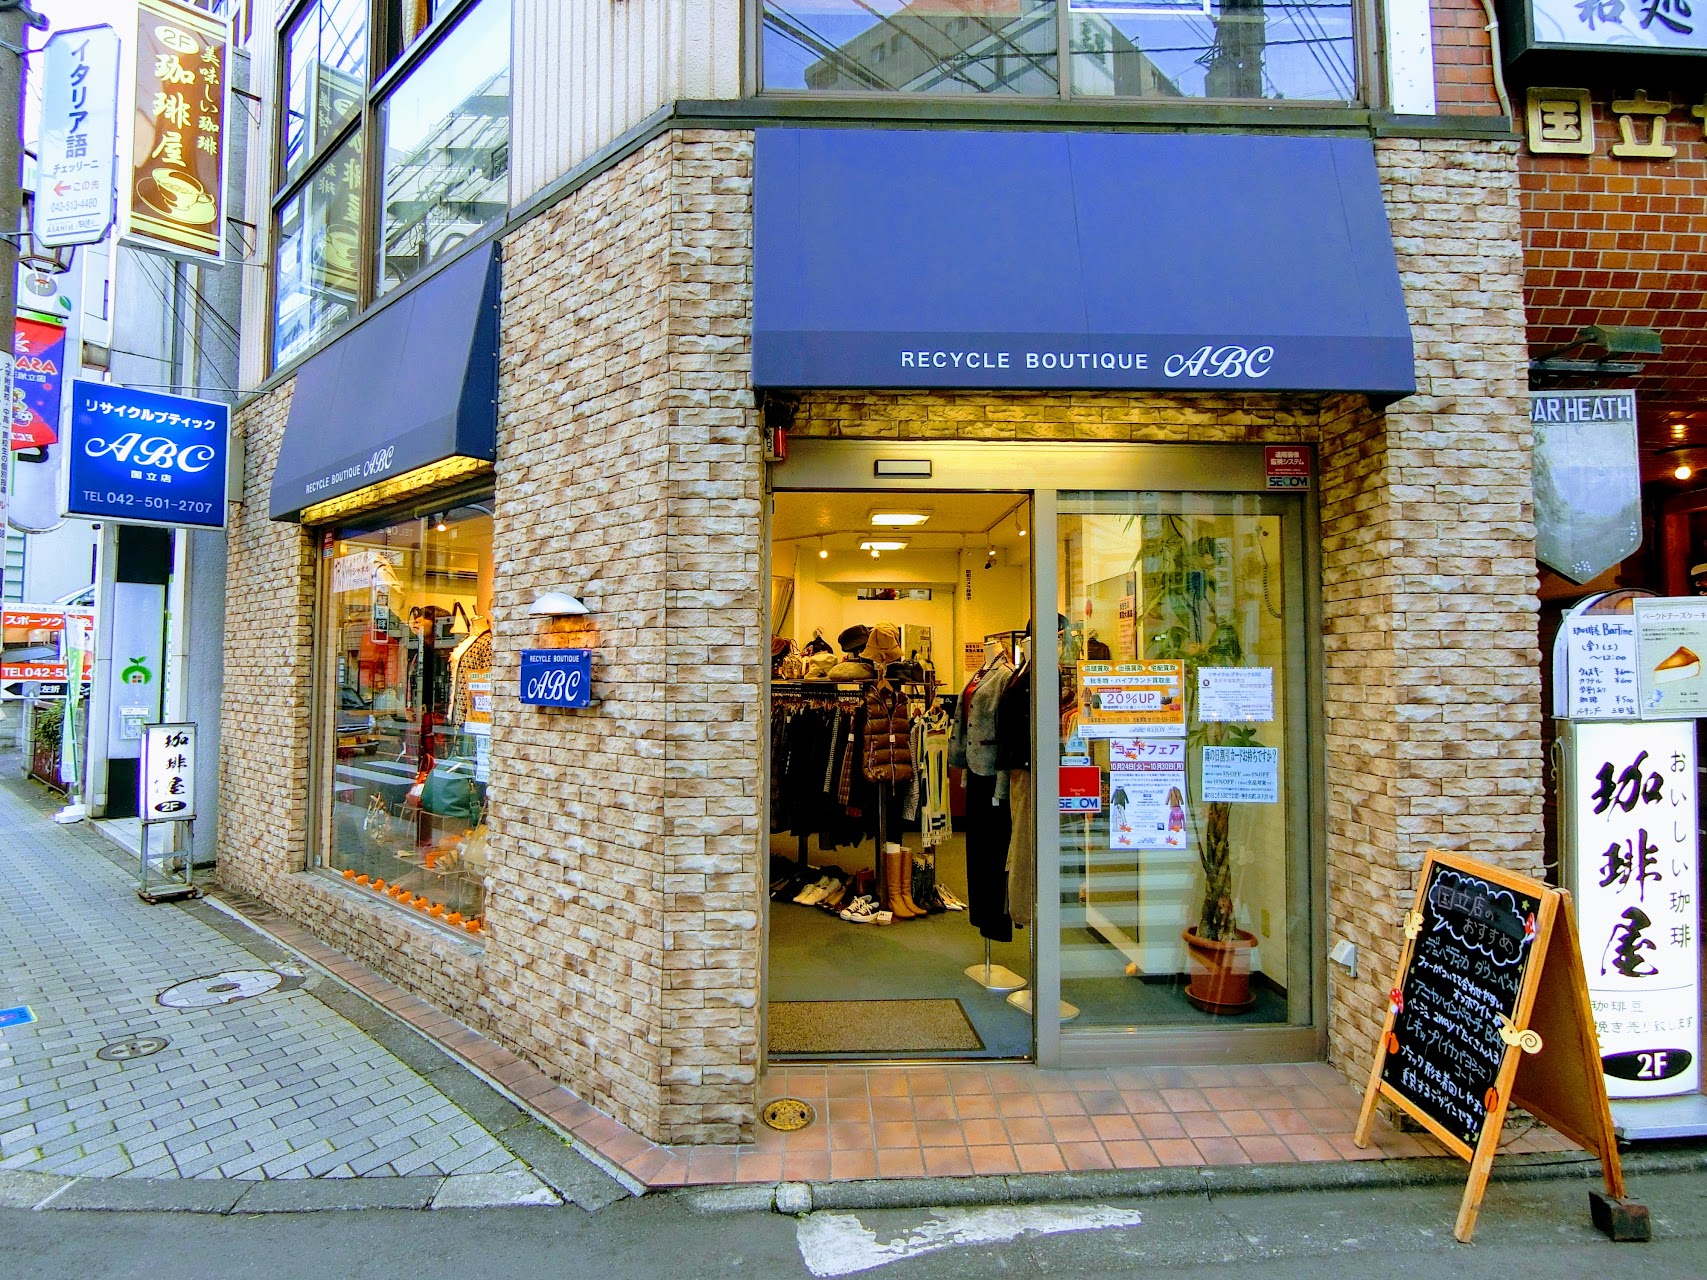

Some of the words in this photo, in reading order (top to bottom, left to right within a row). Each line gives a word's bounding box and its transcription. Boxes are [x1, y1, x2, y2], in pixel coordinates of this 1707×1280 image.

[162, 29, 192, 49] 2F
[65, 38, 90, 159] イタリア語
[151, 53, 196, 168] 珈琲屋
[197, 45, 221, 156] 美味しい珈琲
[1526, 87, 1707, 158] 国立
[73, 180, 100, 192] この先
[901, 352, 1010, 368] RECYCLE
[1025, 352, 1149, 370] BOUTIQUE
[1163, 345, 1275, 379] ABC
[86, 398, 216, 431] リサイクルブティック
[1529, 398, 1561, 422] AR
[1565, 397, 1631, 423] HEATH
[85, 432, 216, 474] ABC
[131, 470, 172, 484] 国立店
[305, 475, 330, 495] RECYCLE
[331, 466, 361, 487] BOUTIQUE
[363, 445, 395, 477] ABC
[1269, 476, 1308, 487] SECOM
[83, 490, 103, 504] TEL
[107, 492, 213, 514] 042-501-2707
[530, 655, 551, 663] RECYCLE
[553, 655, 580, 664] BOUTIQUE
[527, 669, 581, 702] ABC
[163, 731, 189, 795] 珈琲屋
[1115, 744, 1180, 756] コートフェア
[161, 801, 179, 812] 2F
[1591, 750, 1665, 978] 珈琲屋
[1669, 750, 1692, 949] おいしい珈琲
[1437, 884, 1495, 921] 国立店の
[1462, 917, 1514, 955] おすすめ
[1474, 959, 1519, 995] ダウンベスト
[1407, 997, 1431, 1020] ベージュ
[1590, 1000, 1644, 1013] 珈琲豆
[1454, 1063, 1475, 1086] コート
[1636, 1051, 1668, 1078] 2F
